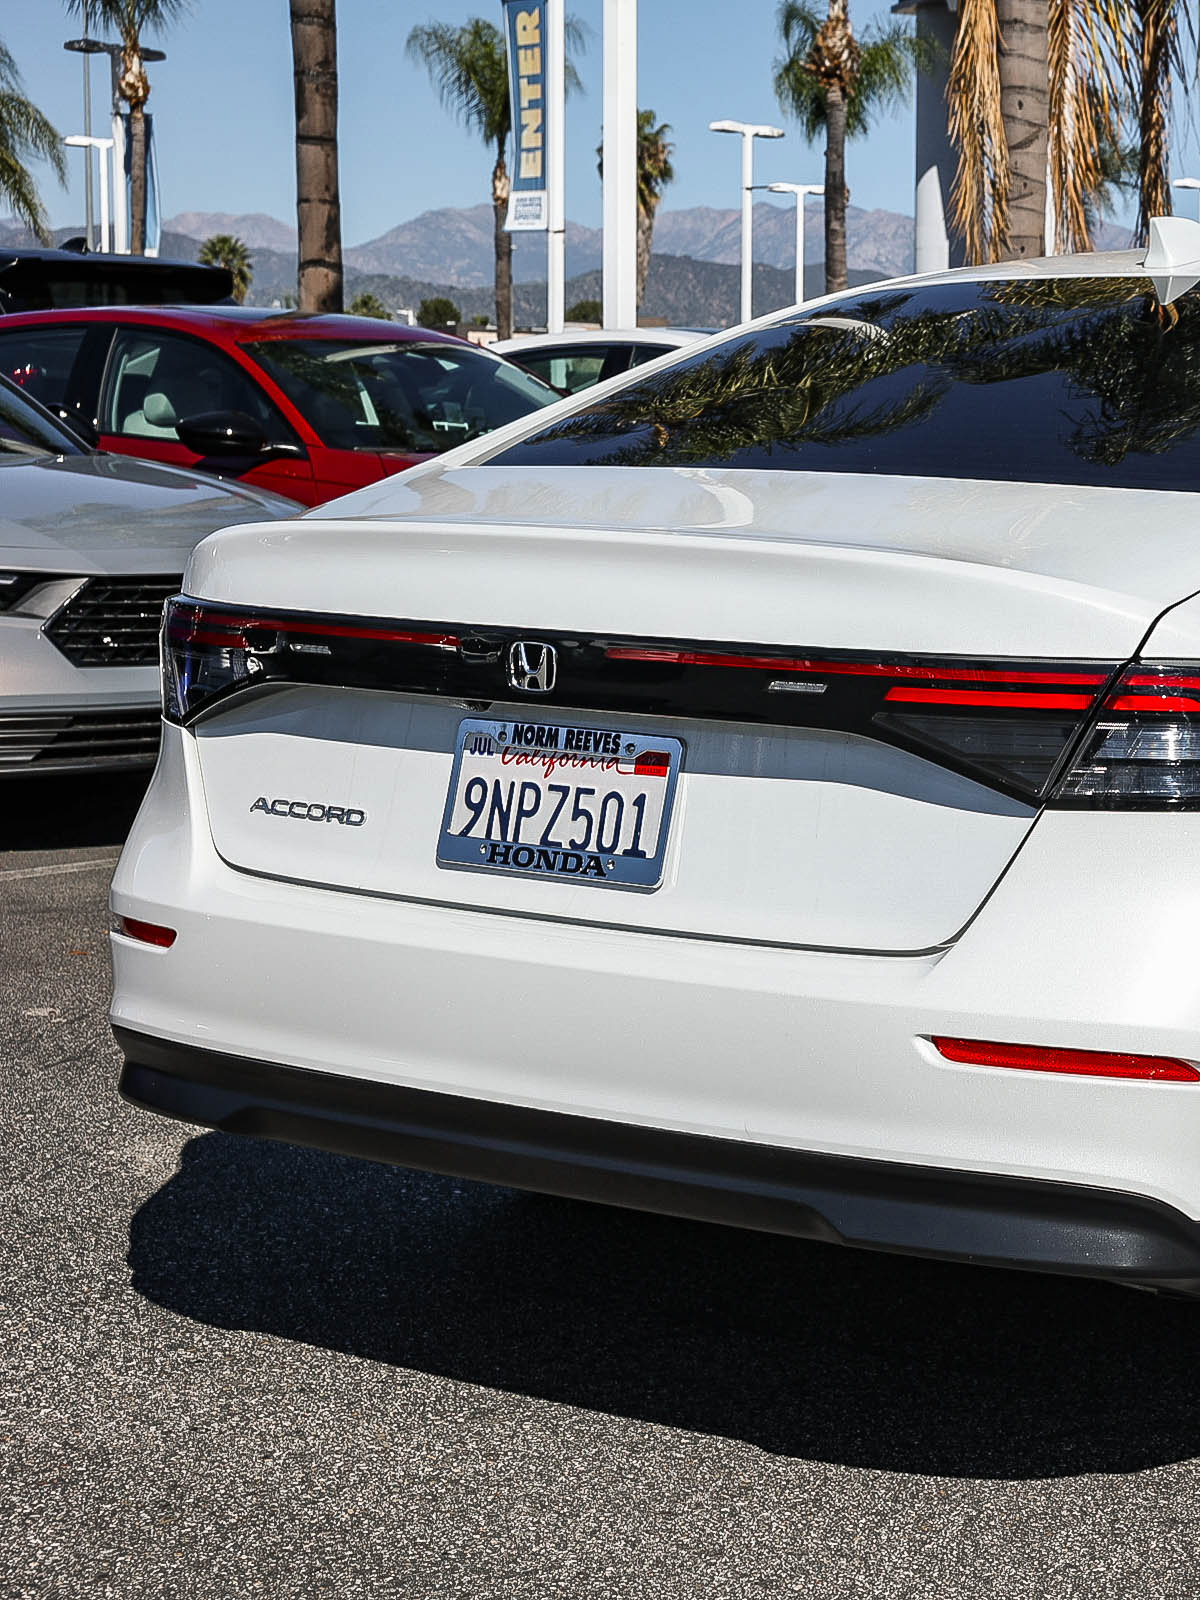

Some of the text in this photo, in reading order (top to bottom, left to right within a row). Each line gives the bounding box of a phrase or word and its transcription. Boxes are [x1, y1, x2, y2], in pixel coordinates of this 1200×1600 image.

[516, 7, 543, 179] ENTER
[469, 737, 494, 756] JUL
[511, 723, 622, 753] NORM REEVES
[501, 747, 634, 778] California
[249, 796, 366, 826] ACCORD
[458, 776, 647, 859] 9NPZ501
[485, 842, 607, 877] HONDA
